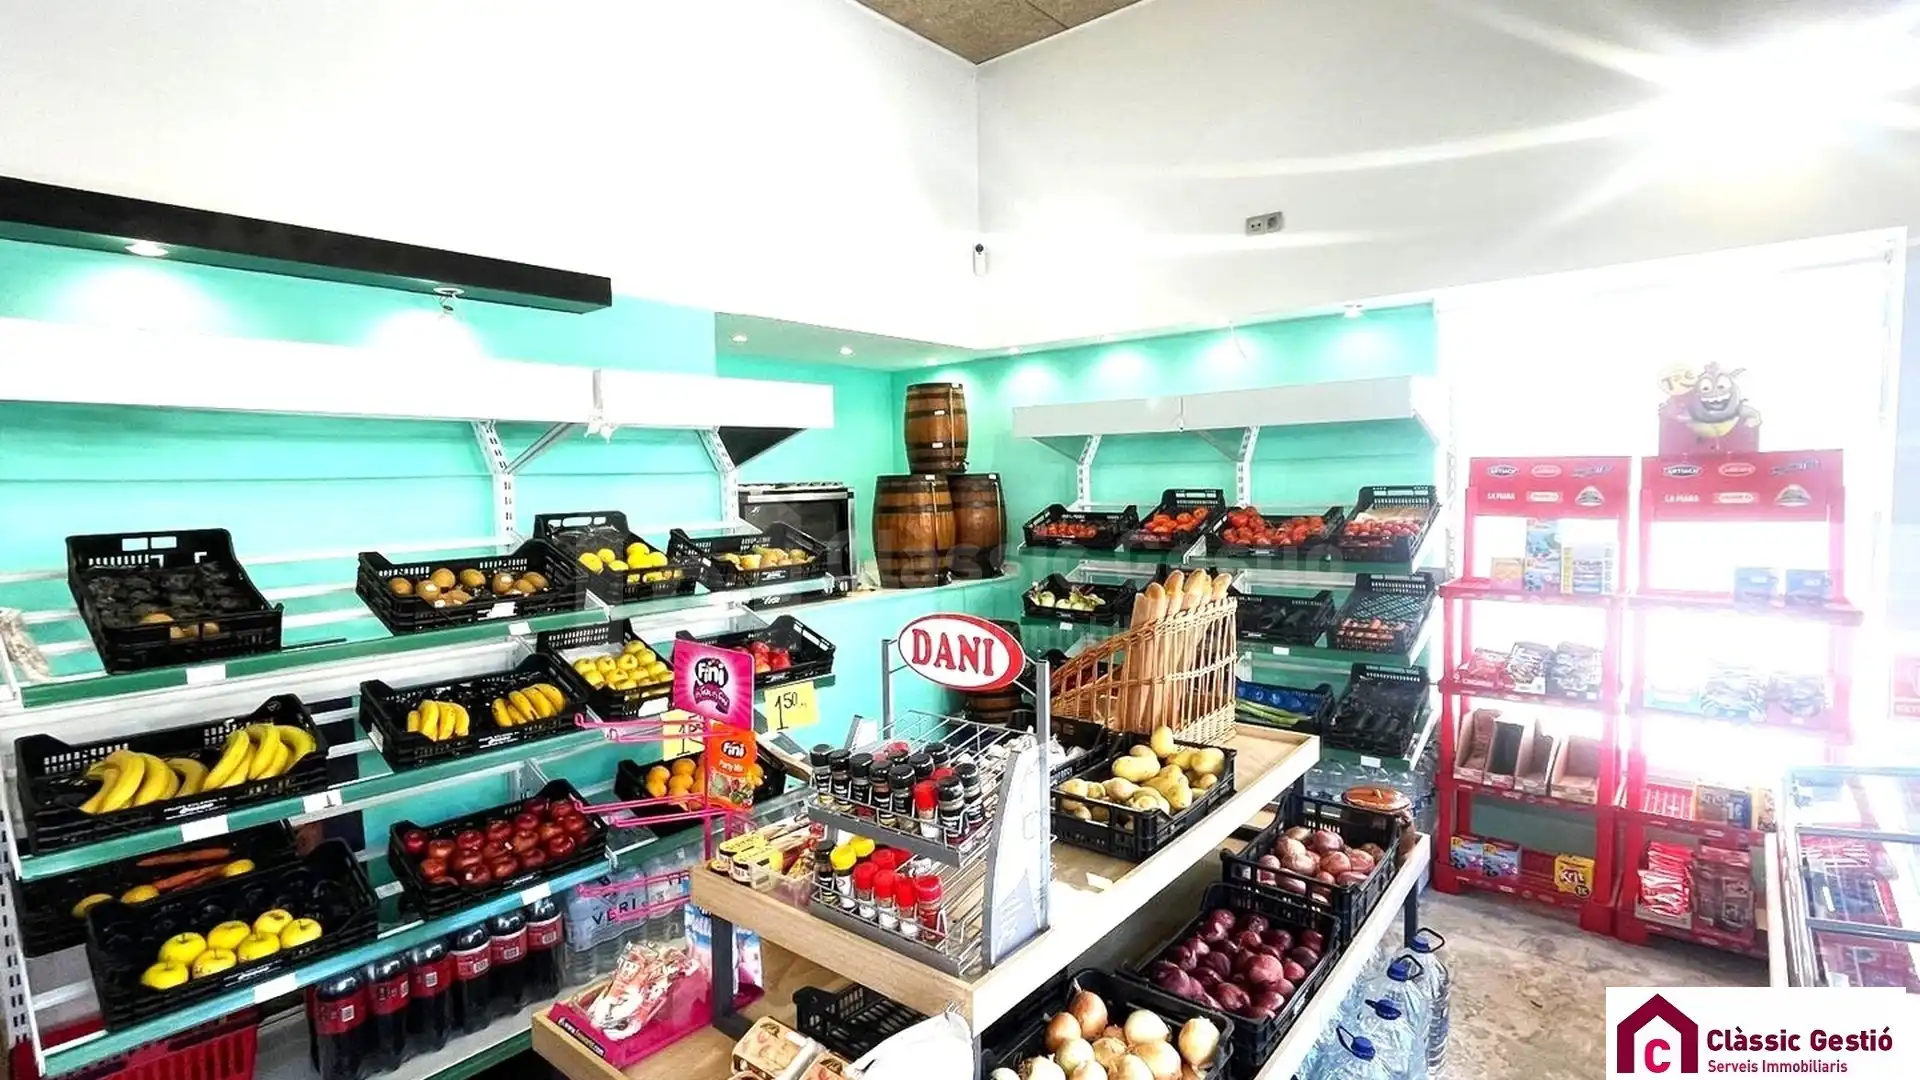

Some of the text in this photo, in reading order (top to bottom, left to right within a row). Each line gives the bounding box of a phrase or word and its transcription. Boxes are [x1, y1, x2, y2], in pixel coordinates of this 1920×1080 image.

[911, 628, 994, 677] DANI
[698, 662, 725, 686] Fini
[723, 742, 745, 757] Fini
[592, 898, 636, 925] VERI
